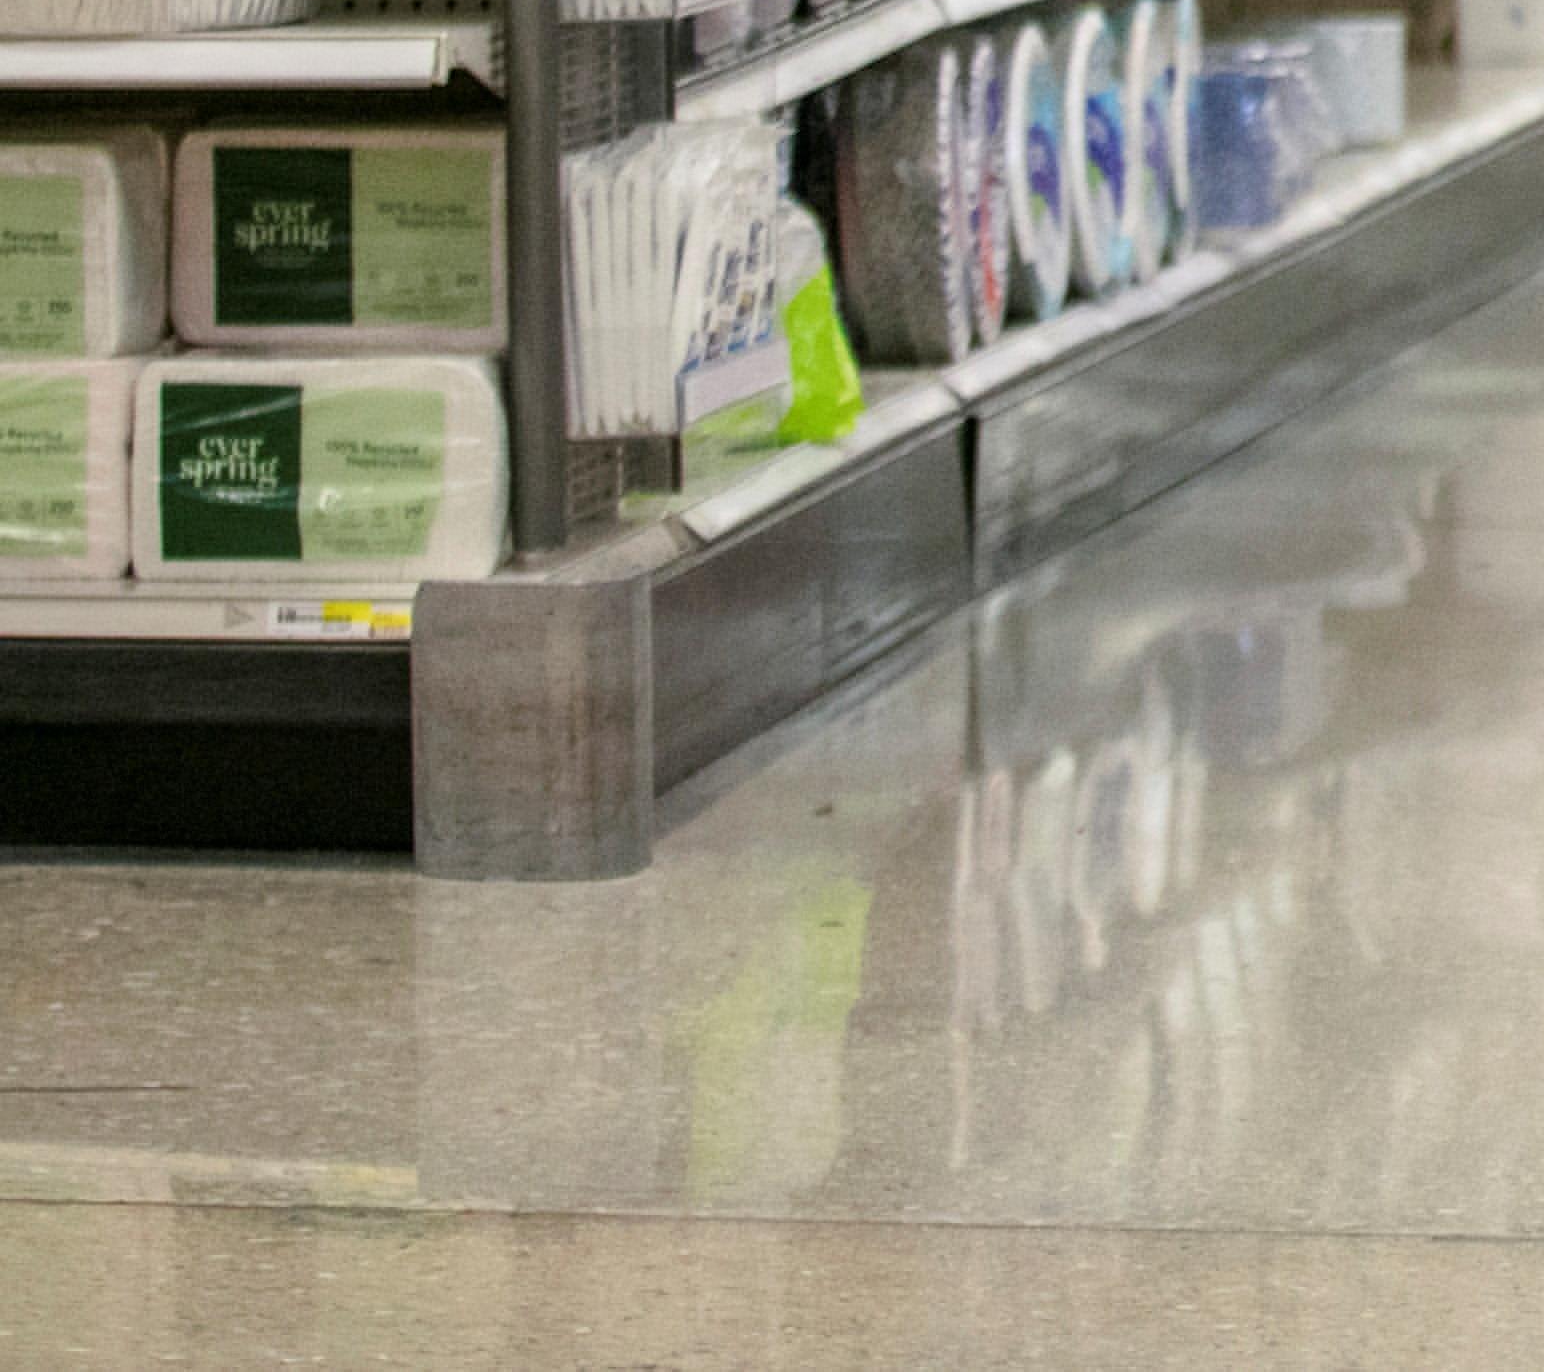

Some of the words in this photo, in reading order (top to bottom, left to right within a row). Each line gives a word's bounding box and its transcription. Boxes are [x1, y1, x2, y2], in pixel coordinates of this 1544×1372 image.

[252, 201, 316, 224] ever
[233, 218, 333, 253] spring
[199, 436, 264, 459] ever
[180, 455, 280, 491] spring
